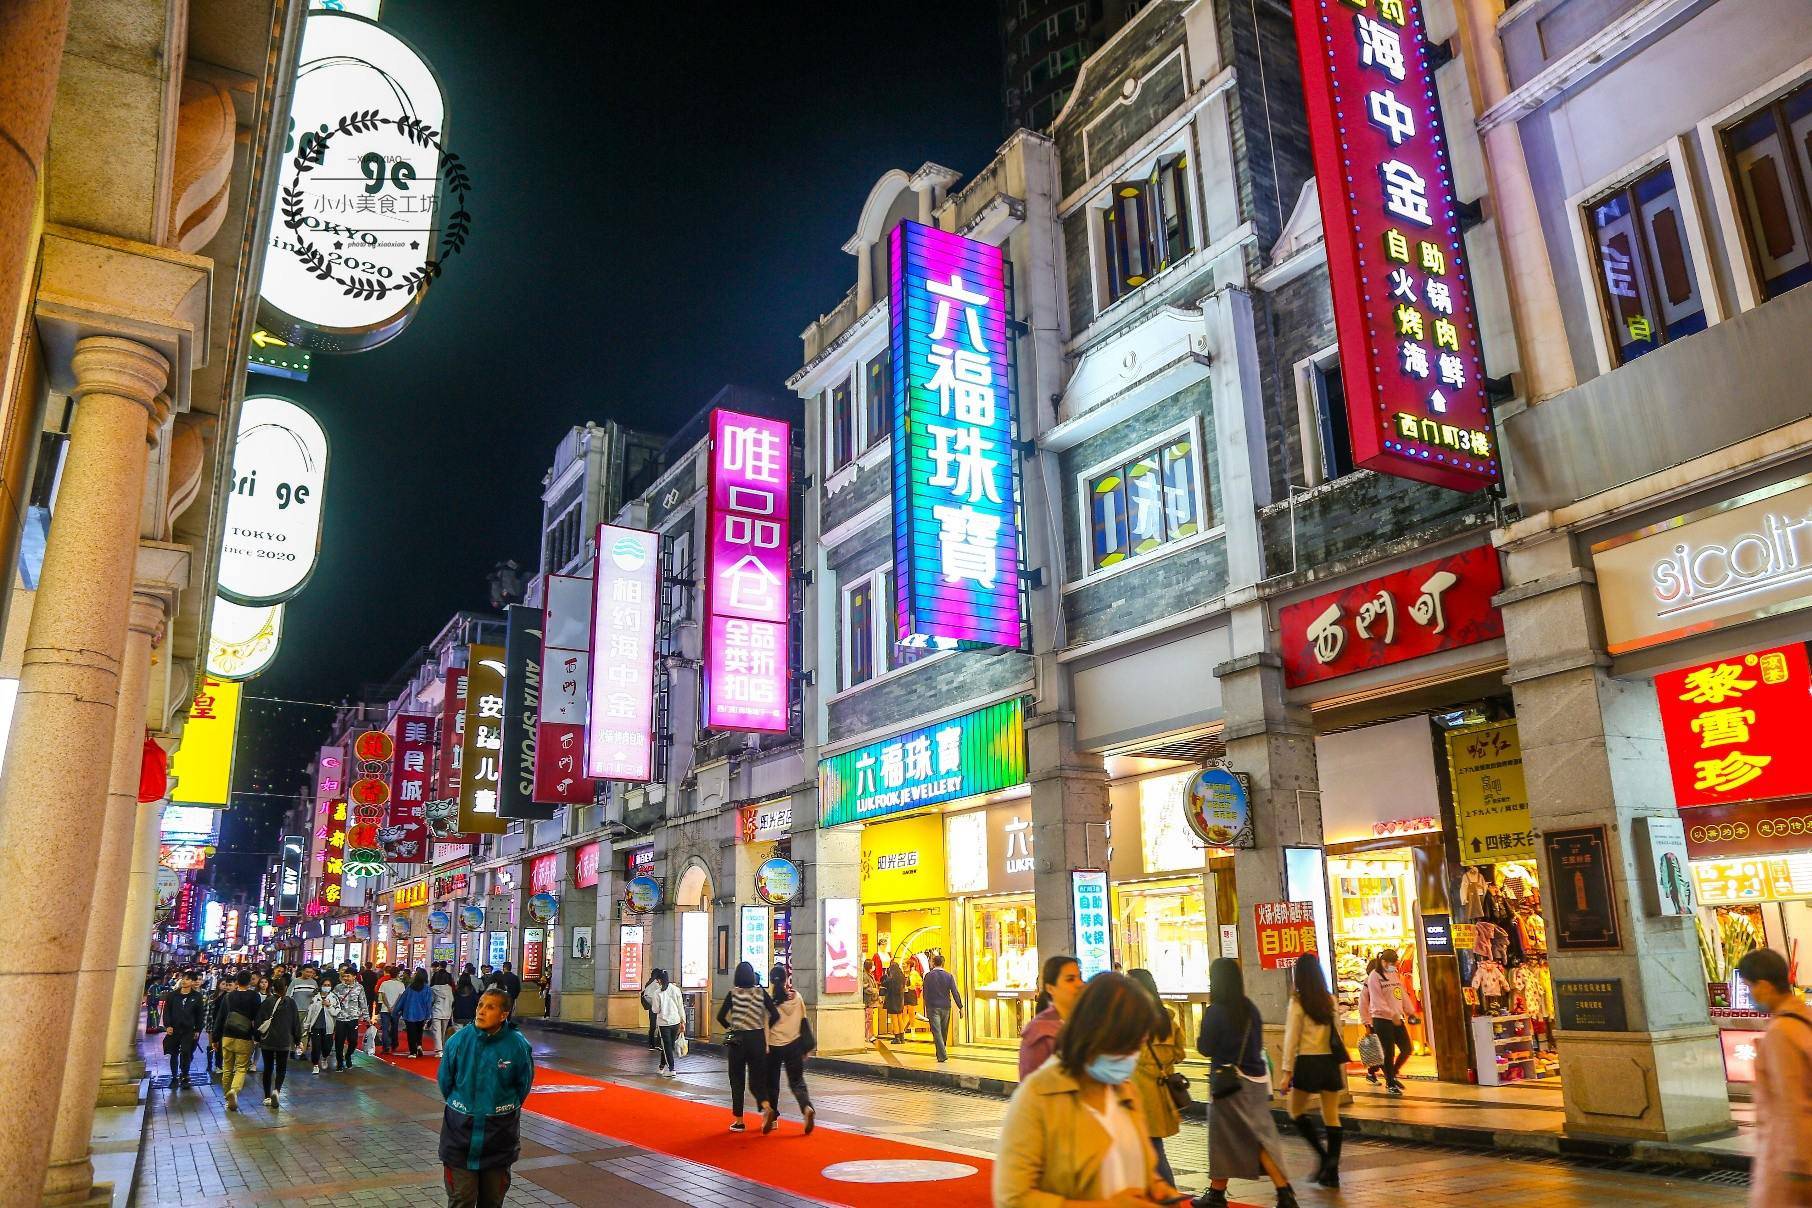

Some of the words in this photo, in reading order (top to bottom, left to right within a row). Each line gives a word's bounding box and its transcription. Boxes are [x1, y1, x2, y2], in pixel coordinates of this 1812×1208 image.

[1356, 13, 1433, 226] 海中金
[300, 214, 378, 245] OKYO
[1386, 229, 1446, 276] 自助
[328, 252, 393, 278] 2020
[1390, 267, 1453, 315] 火锅
[1396, 304, 1460, 351] 烤肉
[1403, 341, 1467, 389] 海鲜
[924, 275, 1002, 590] 六福珠寶
[1398, 412, 1490, 457] 西门町3楼
[276, 482, 310, 510] ge
[720, 425, 783, 612] 唯品仓
[224, 544, 255, 557] ince
[256, 549, 297, 562] 2020
[232, 527, 286, 542] TOKYO
[607, 577, 642, 719] 相约海中金
[401, 722, 427, 802] 美食城
[473, 694, 504, 813] 安踏儿童
[856, 726, 962, 796] 六福珠寶
[878, 851, 917, 870] 阳光名店
[1261, 926, 1318, 955] 自助餐
